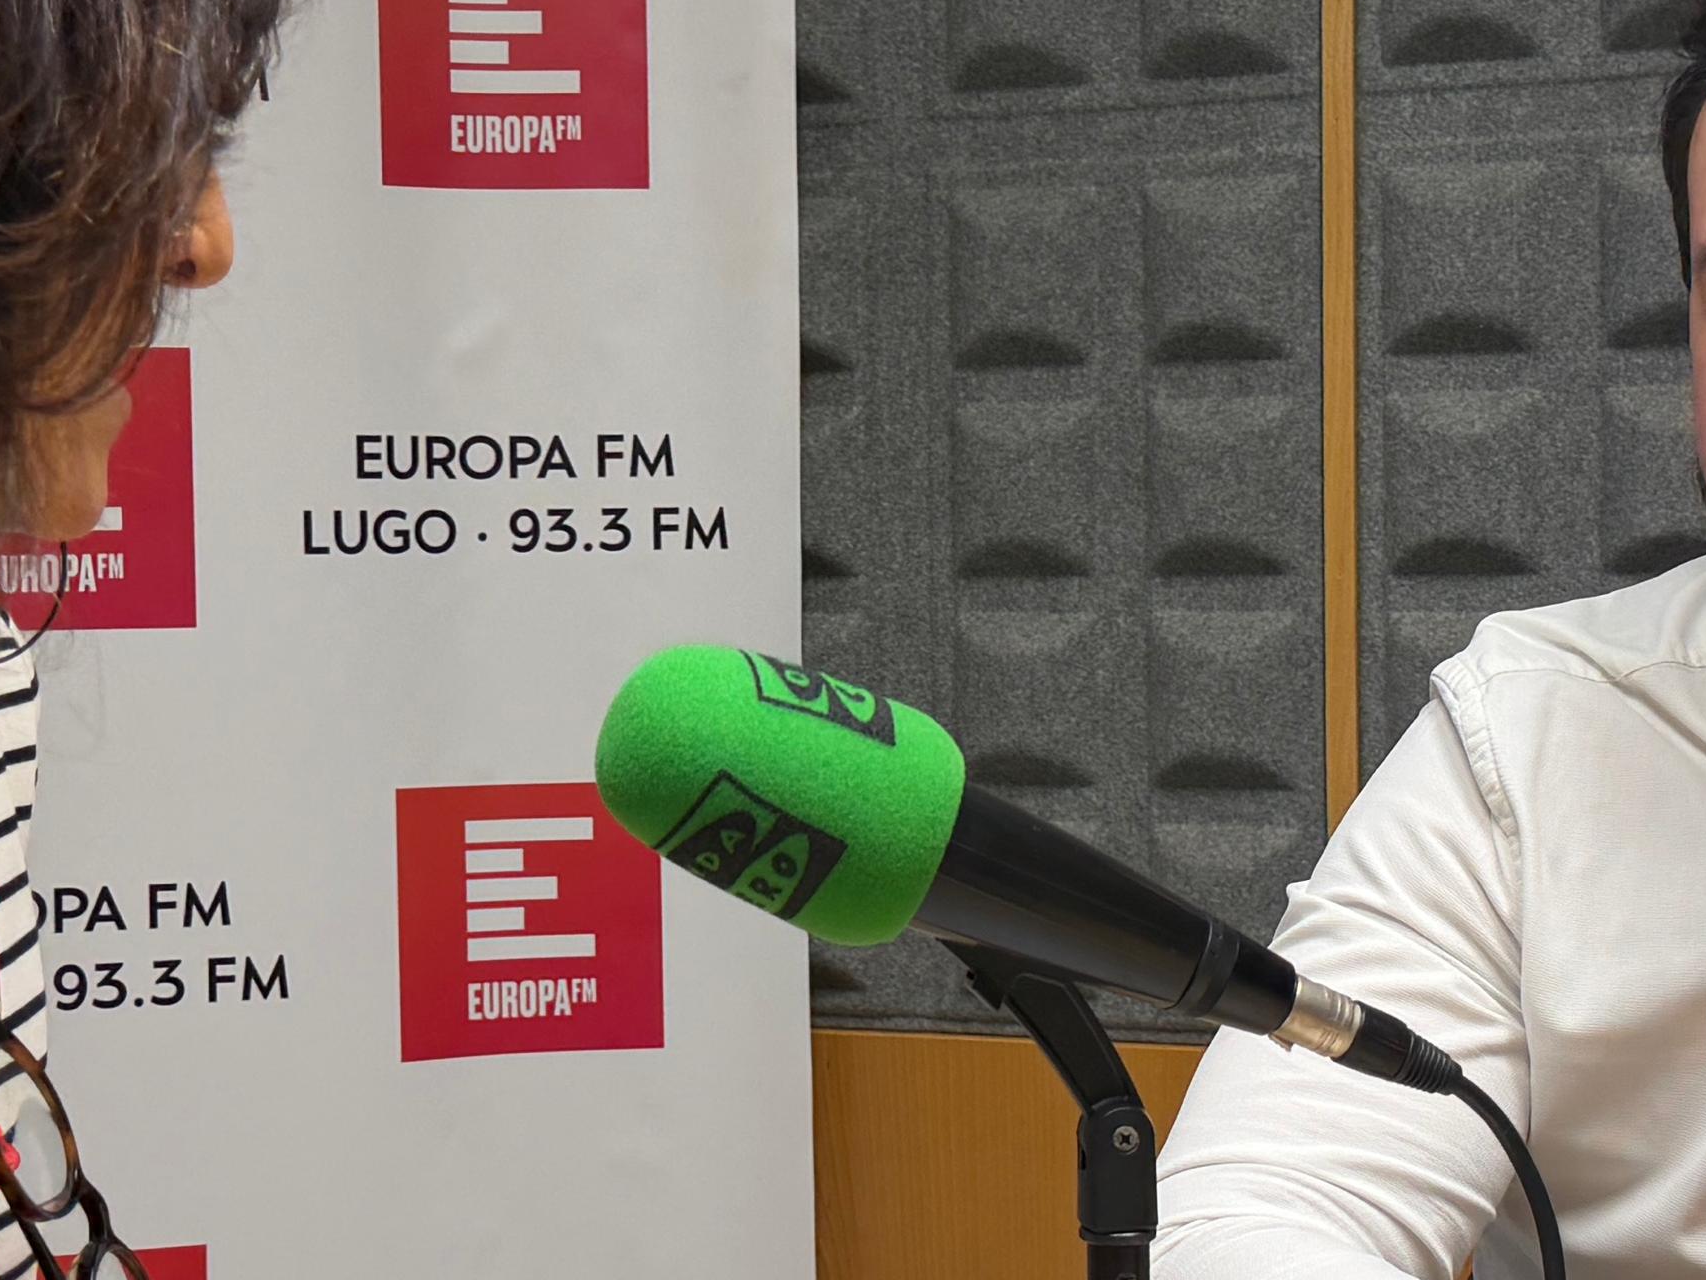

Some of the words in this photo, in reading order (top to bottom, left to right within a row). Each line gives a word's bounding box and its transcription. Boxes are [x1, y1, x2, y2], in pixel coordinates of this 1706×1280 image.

[356, 435, 577, 479] EUROPA
[598, 434, 674, 477] FM
[304, 510, 456, 554] LUGO
[510, 508, 631, 552] 93.3
[653, 507, 728, 550] FM
[149, 881, 230, 929] FM
[54, 960, 184, 1010] 93.3
[208, 955, 288, 1002] FM
